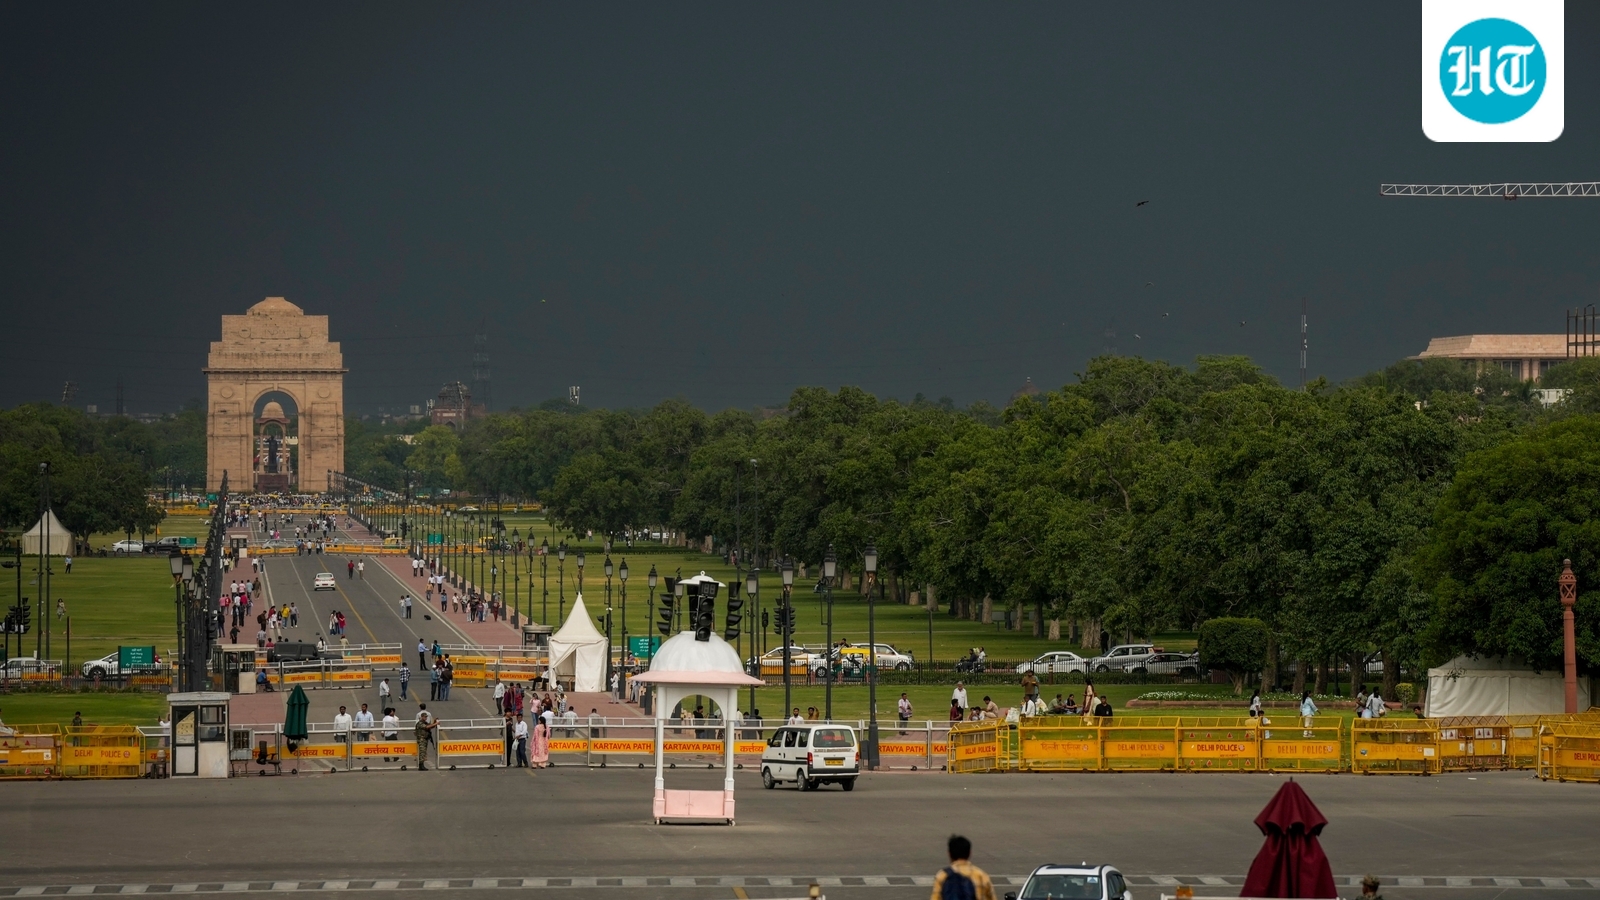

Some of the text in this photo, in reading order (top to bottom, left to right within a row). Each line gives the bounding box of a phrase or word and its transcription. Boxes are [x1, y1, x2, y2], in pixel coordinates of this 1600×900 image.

[393, 746, 406, 754] पथ
[442, 743, 500, 752] KARTAVYA PATH
[548, 742, 581, 750] ARTAVYA
[663, 743, 700, 751] KARTAVYA
[977, 745, 991, 753] POLICE
[1117, 743, 1158, 751] DELHI POLICE
[1196, 744, 1238, 752] DELHI POLICE
[1277, 745, 1328, 755] DELHI POLICE
[1392, 745, 1417, 753] POLICE
[74, 749, 122, 759] DELHI POLICE
[323, 748, 335, 756] पथ
[1574, 752, 1587, 761] DELHI
